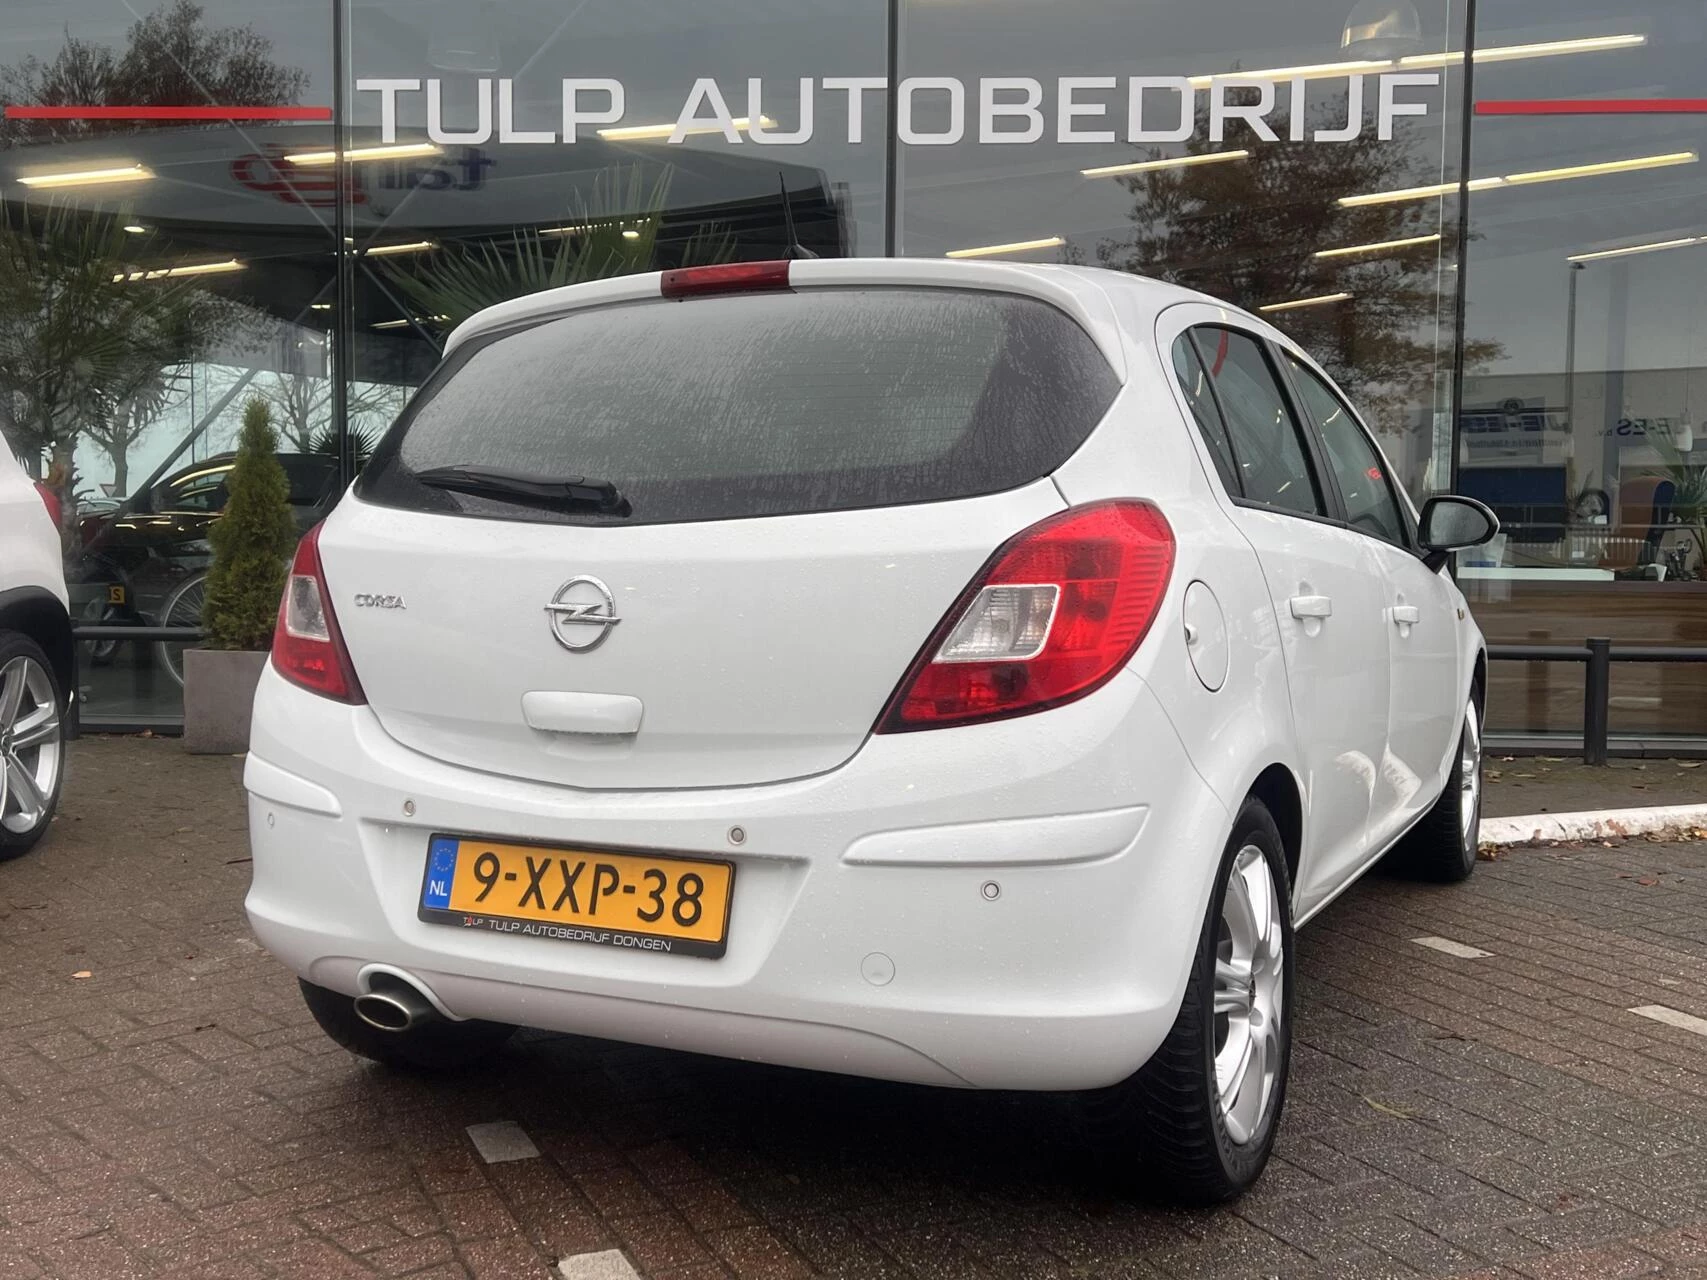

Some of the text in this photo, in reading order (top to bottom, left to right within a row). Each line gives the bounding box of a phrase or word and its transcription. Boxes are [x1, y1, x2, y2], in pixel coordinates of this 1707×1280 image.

[356, 73, 1439, 145] TULP AUTOBEDRIJF
[354, 593, 407, 610] CORSA
[429, 851, 704, 927] NL 9-XXP-38
[489, 919, 520, 932] TULP
[523, 924, 610, 943] AUTOBEDRIJF
[613, 934, 671, 951] DONGEN
